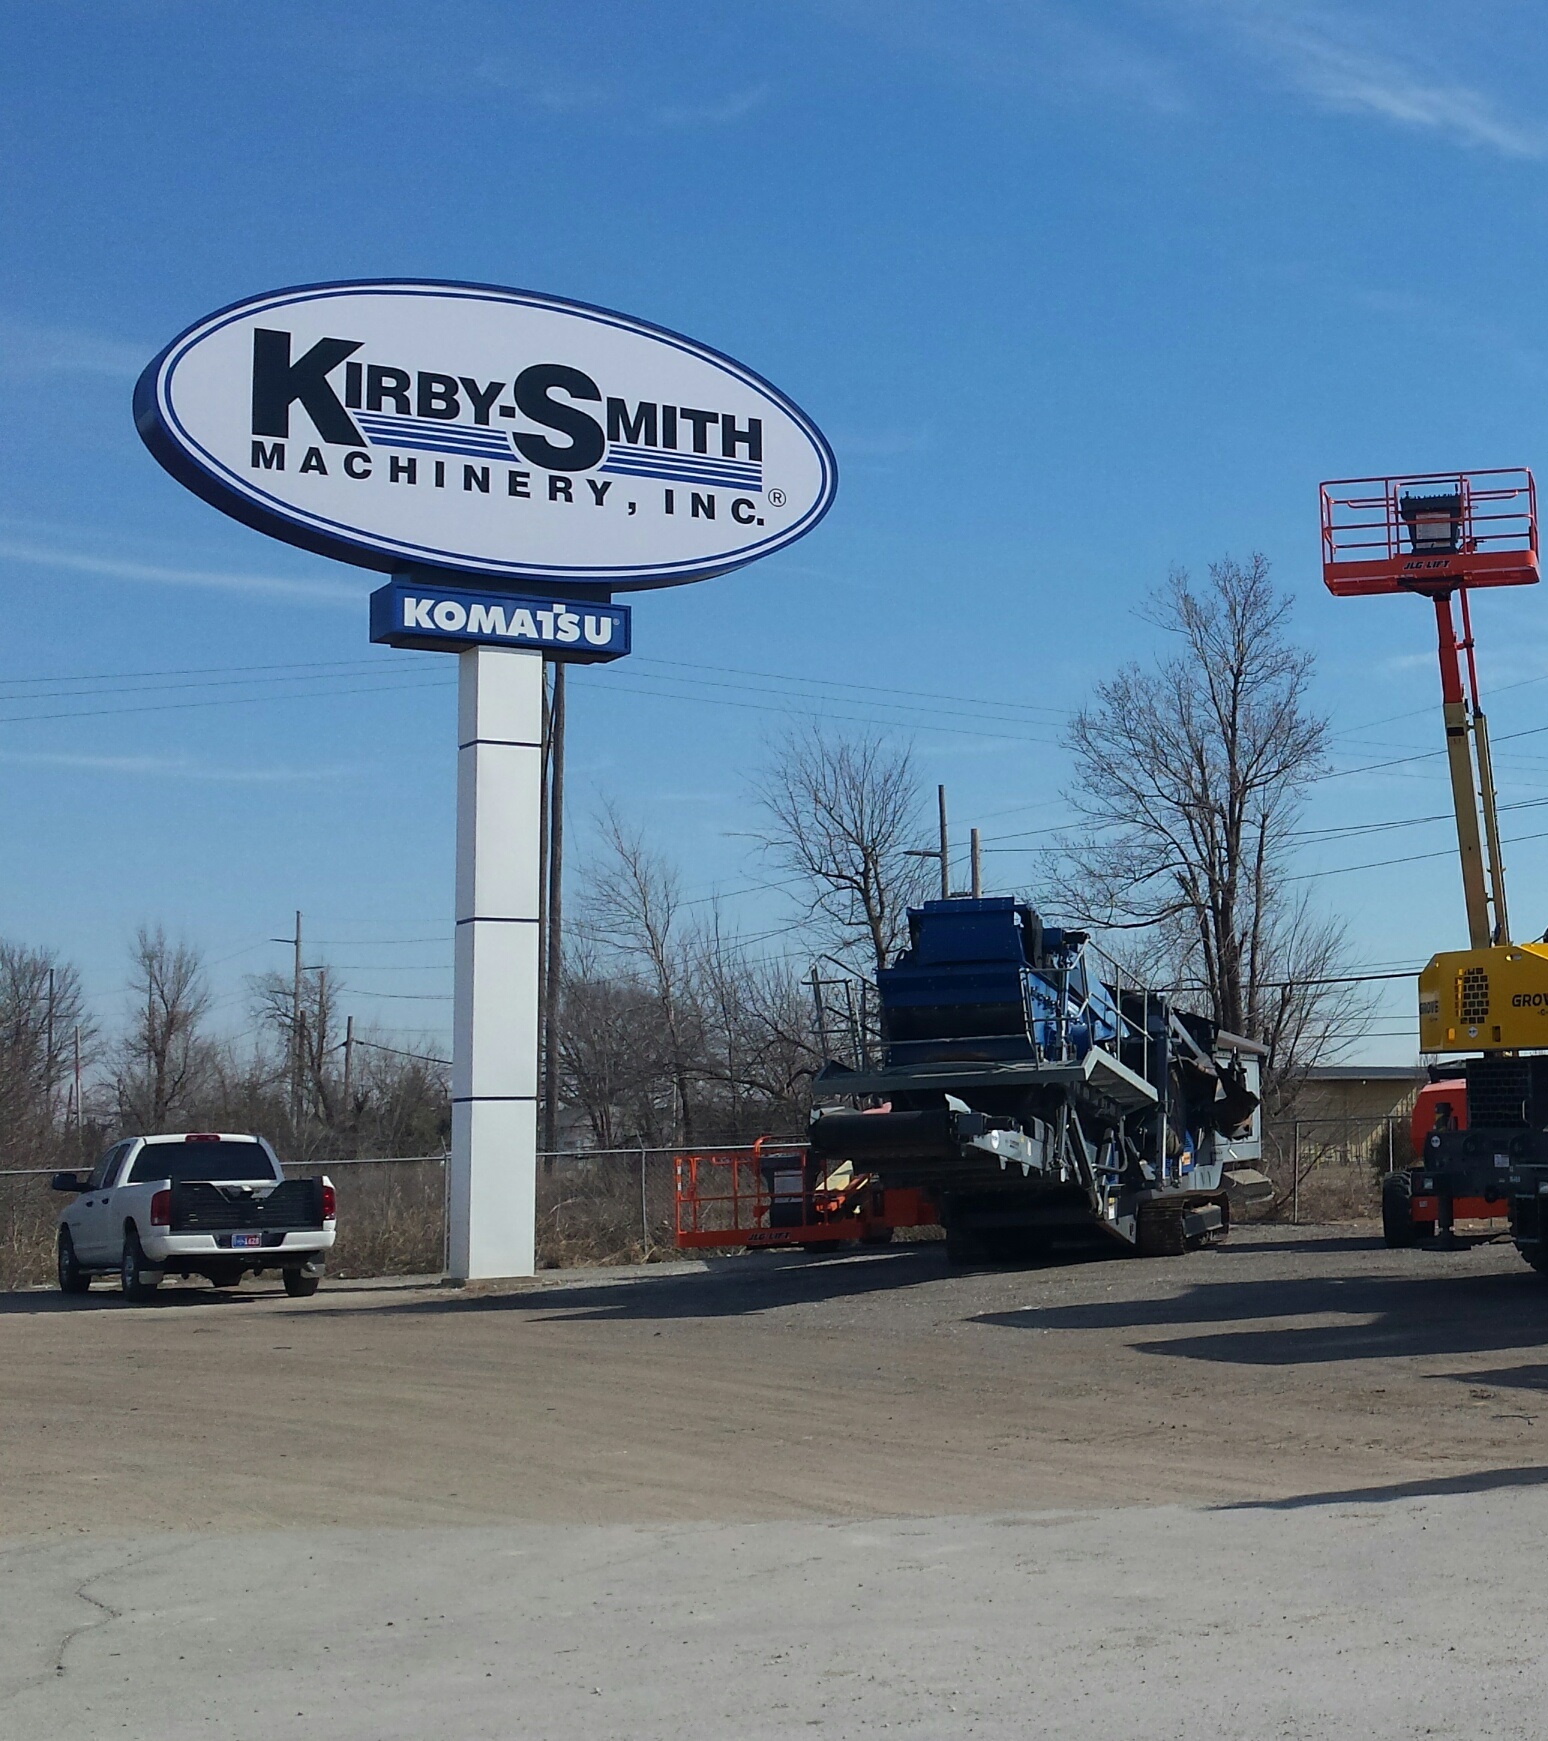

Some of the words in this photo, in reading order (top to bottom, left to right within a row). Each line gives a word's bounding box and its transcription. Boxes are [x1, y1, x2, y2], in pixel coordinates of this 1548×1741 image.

[251, 328, 763, 474] KIRBY-SMITH
[664, 494, 766, 527] INC.
[1404, 561, 1423, 570] JLG
[1426, 560, 1451, 569] LIFT
[403, 597, 613, 646] KOMATSU
[748, 1233, 766, 1241] JLG
[769, 1231, 790, 1240] LIFT
